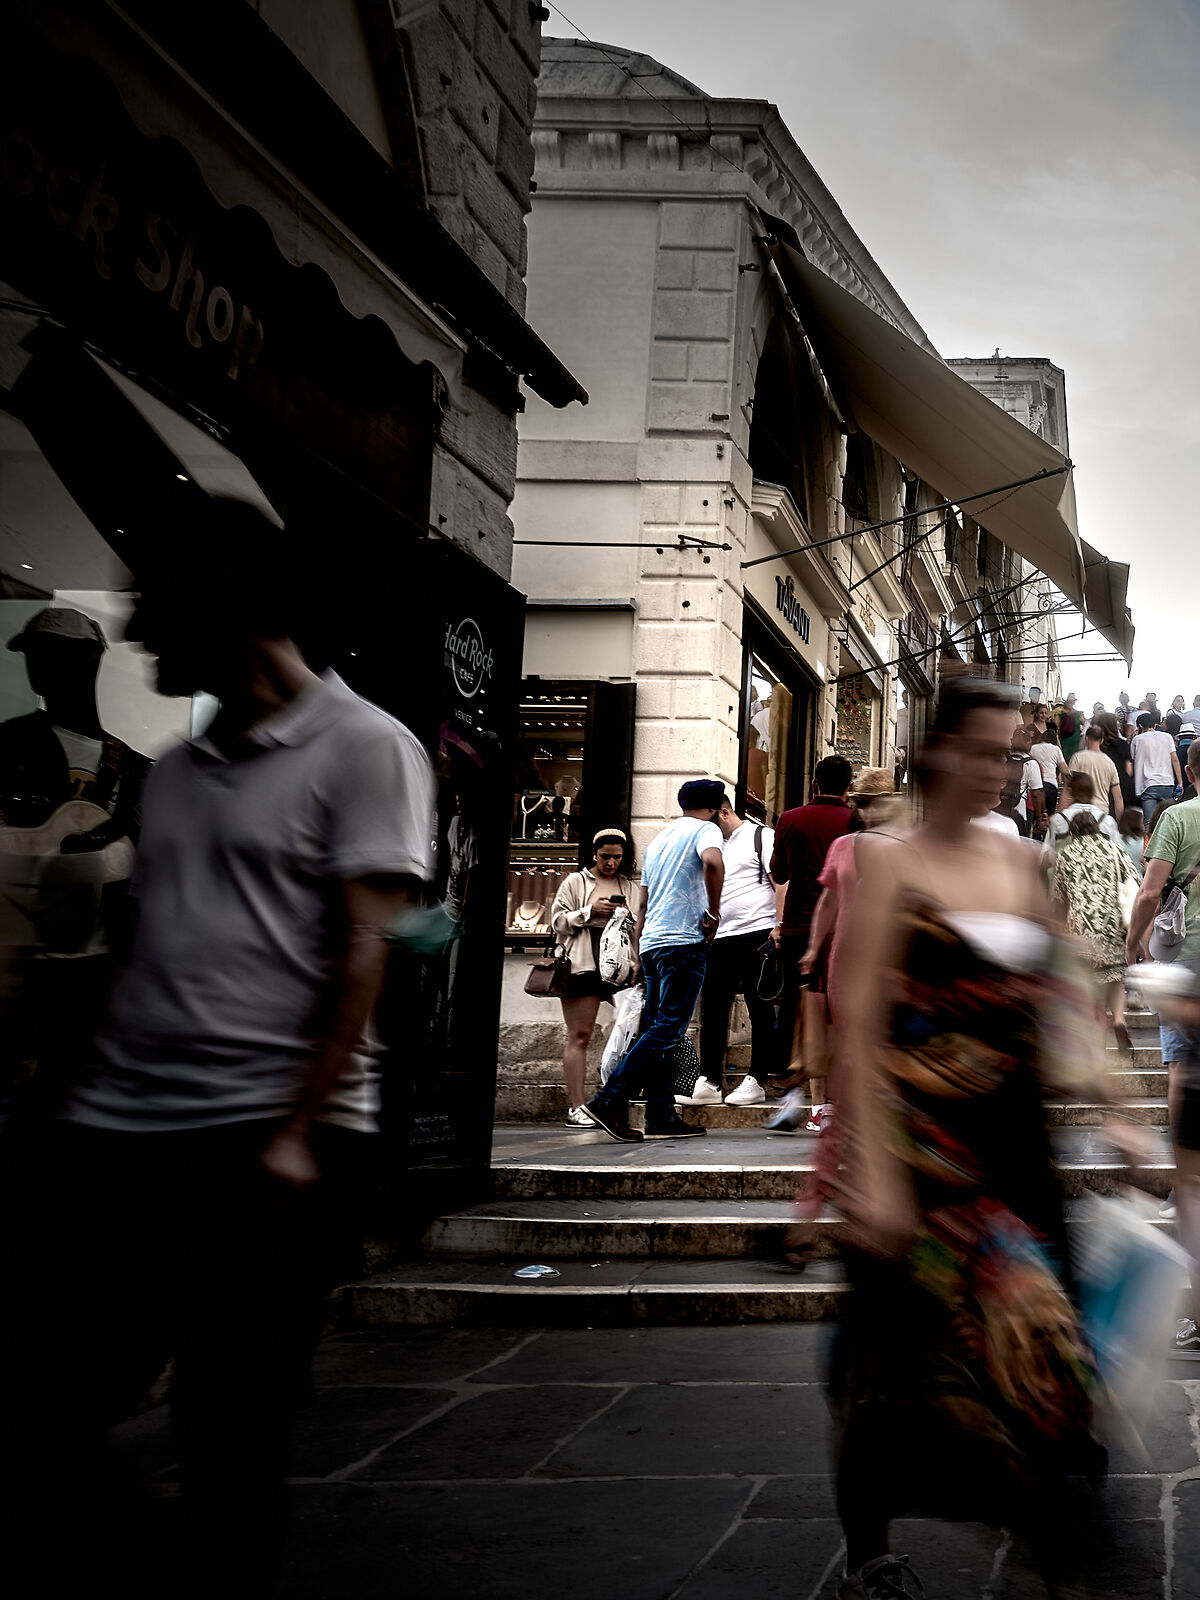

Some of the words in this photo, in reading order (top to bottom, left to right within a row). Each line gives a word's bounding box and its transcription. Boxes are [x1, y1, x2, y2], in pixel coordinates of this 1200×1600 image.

[1, 128, 119, 280] ock
[136, 211, 264, 381] Shop
[469, 638, 494, 680] Rock
